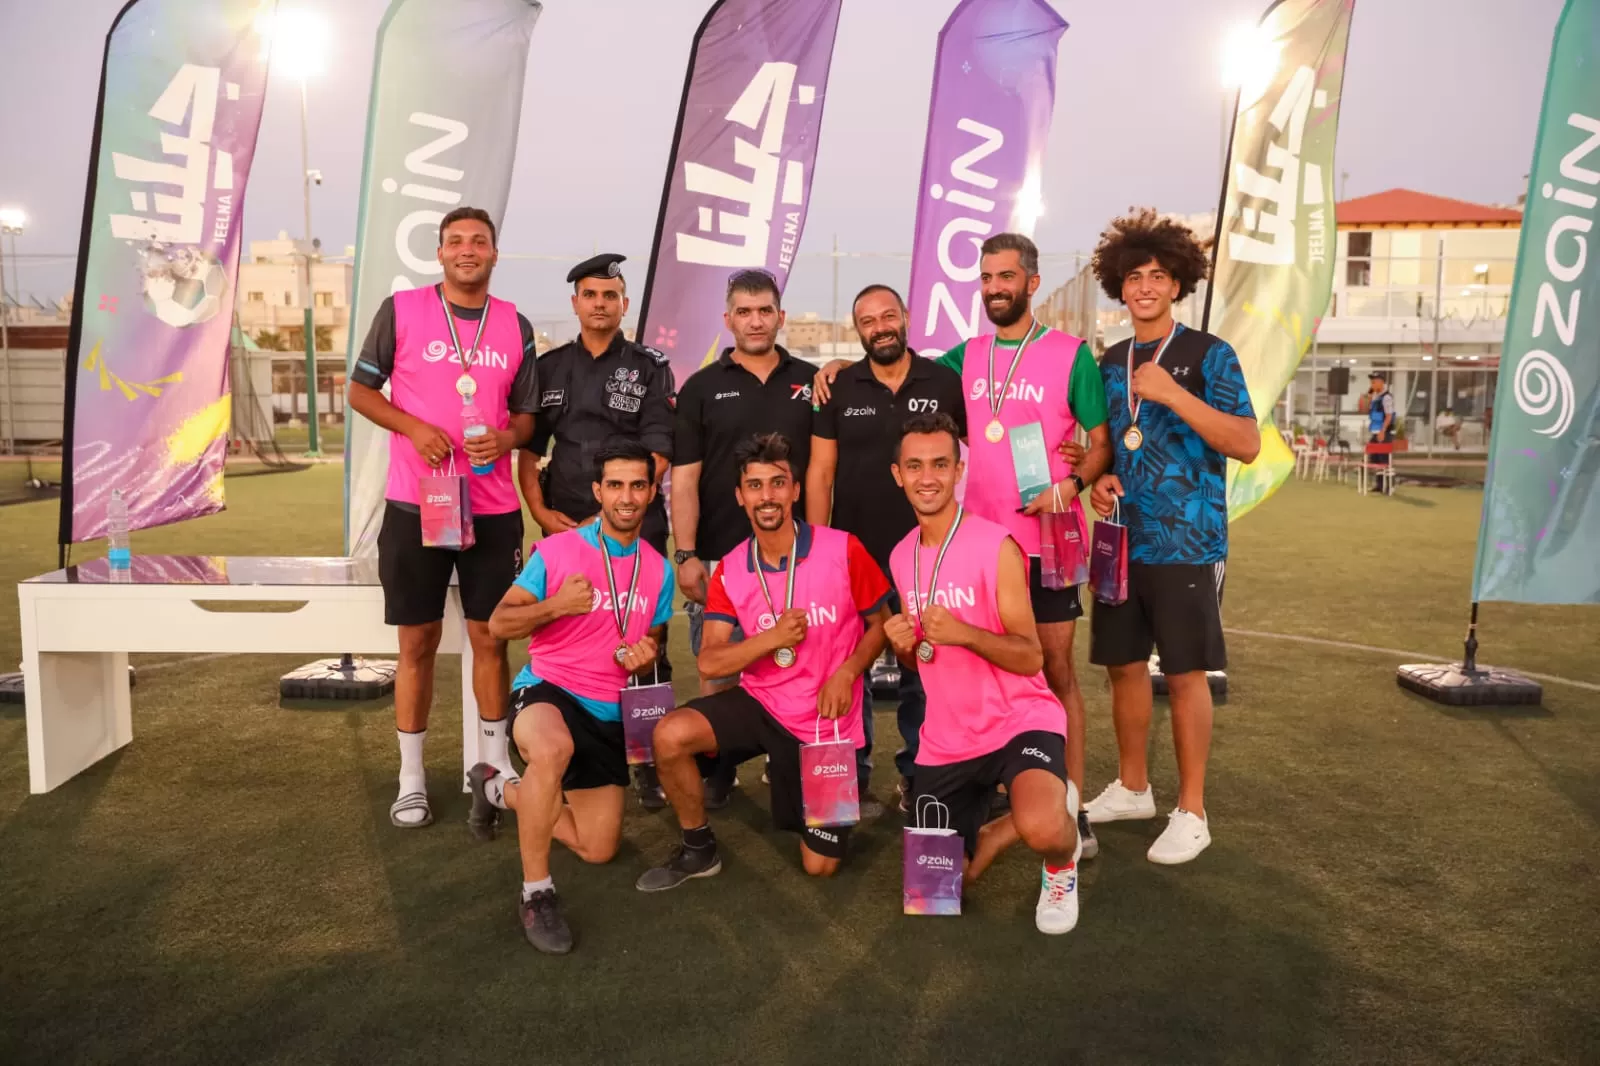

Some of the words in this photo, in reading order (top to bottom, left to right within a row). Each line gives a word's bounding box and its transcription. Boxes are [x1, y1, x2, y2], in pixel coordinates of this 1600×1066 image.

[214, 194, 233, 247] JEELNA
[779, 212, 801, 273] JEELNA
[1308, 208, 1325, 264] JEELNA
[908, 398, 938, 413] 079
